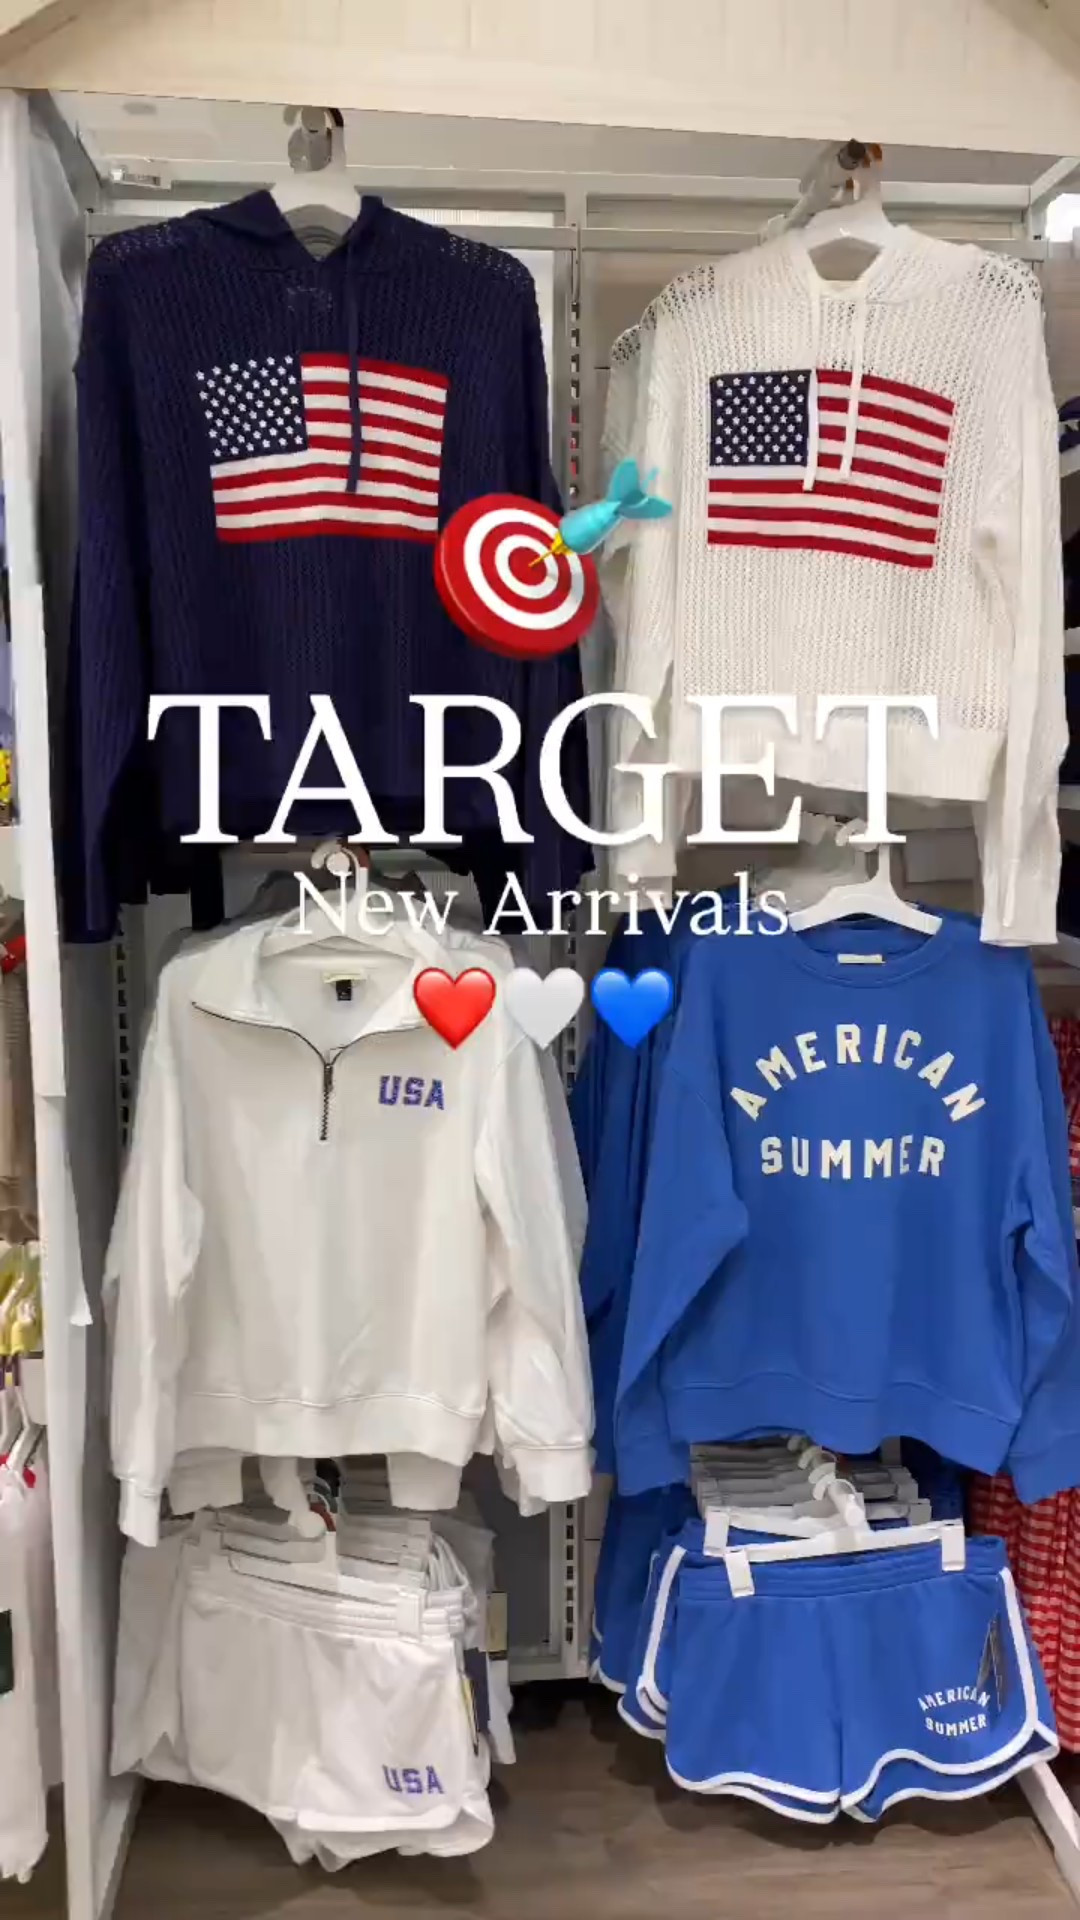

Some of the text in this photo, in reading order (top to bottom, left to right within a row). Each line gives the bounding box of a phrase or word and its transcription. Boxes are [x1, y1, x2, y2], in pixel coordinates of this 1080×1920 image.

[729, 1023, 987, 1122] AMERICAN
[378, 1075, 445, 1111] USA
[760, 1135, 946, 1179] SUMMER
[917, 1685, 991, 1711] AMERICAN
[925, 1713, 987, 1737] SUMMER
[383, 1764, 444, 1796] USA
